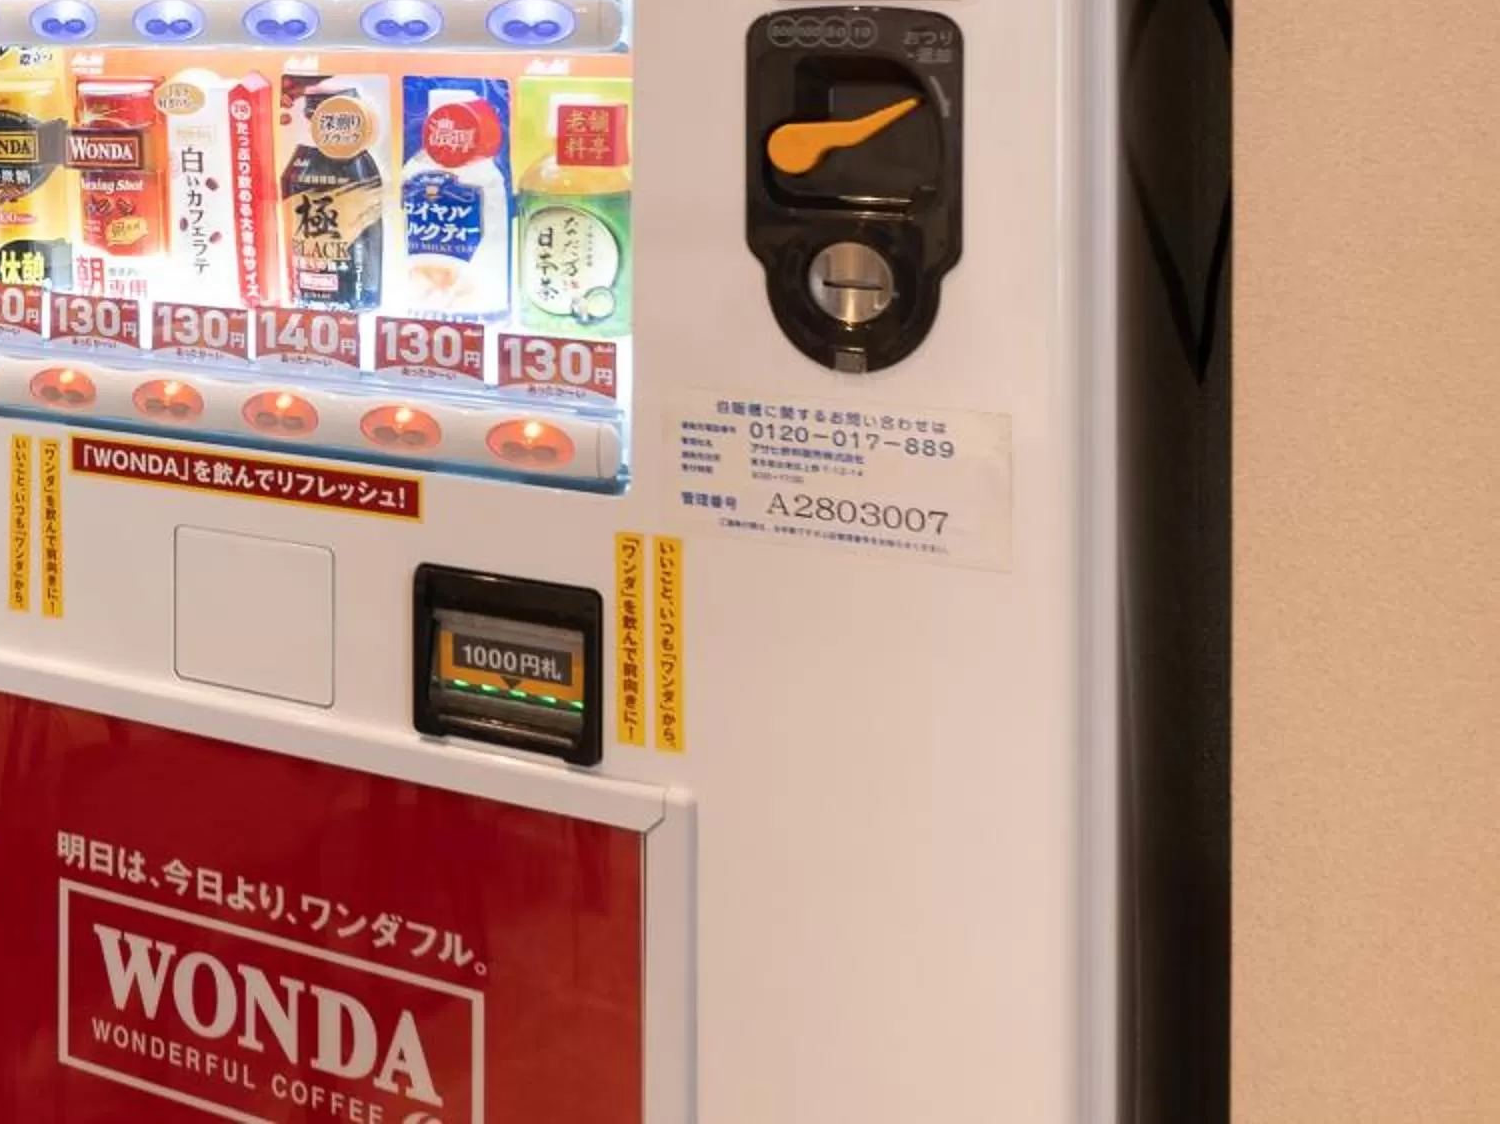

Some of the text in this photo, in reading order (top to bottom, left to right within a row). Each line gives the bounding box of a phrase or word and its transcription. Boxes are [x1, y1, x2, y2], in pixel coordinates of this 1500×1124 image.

[69, 137, 134, 161] WONDA
[181, 147, 210, 274] 白いカフェラテ
[406, 222, 481, 244] ルクティー
[749, 422, 956, 459] 0120-017-889
[680, 491, 738, 510] 管理番号
[766, 492, 949, 536] A2803007
[460, 643, 563, 681] 1000円札
[57, 830, 488, 976] 明日は、今日より、ワンダフル。
[92, 922, 444, 1108] WONDA
[91, 1016, 384, 1124] WONDERFUL COFFEE
